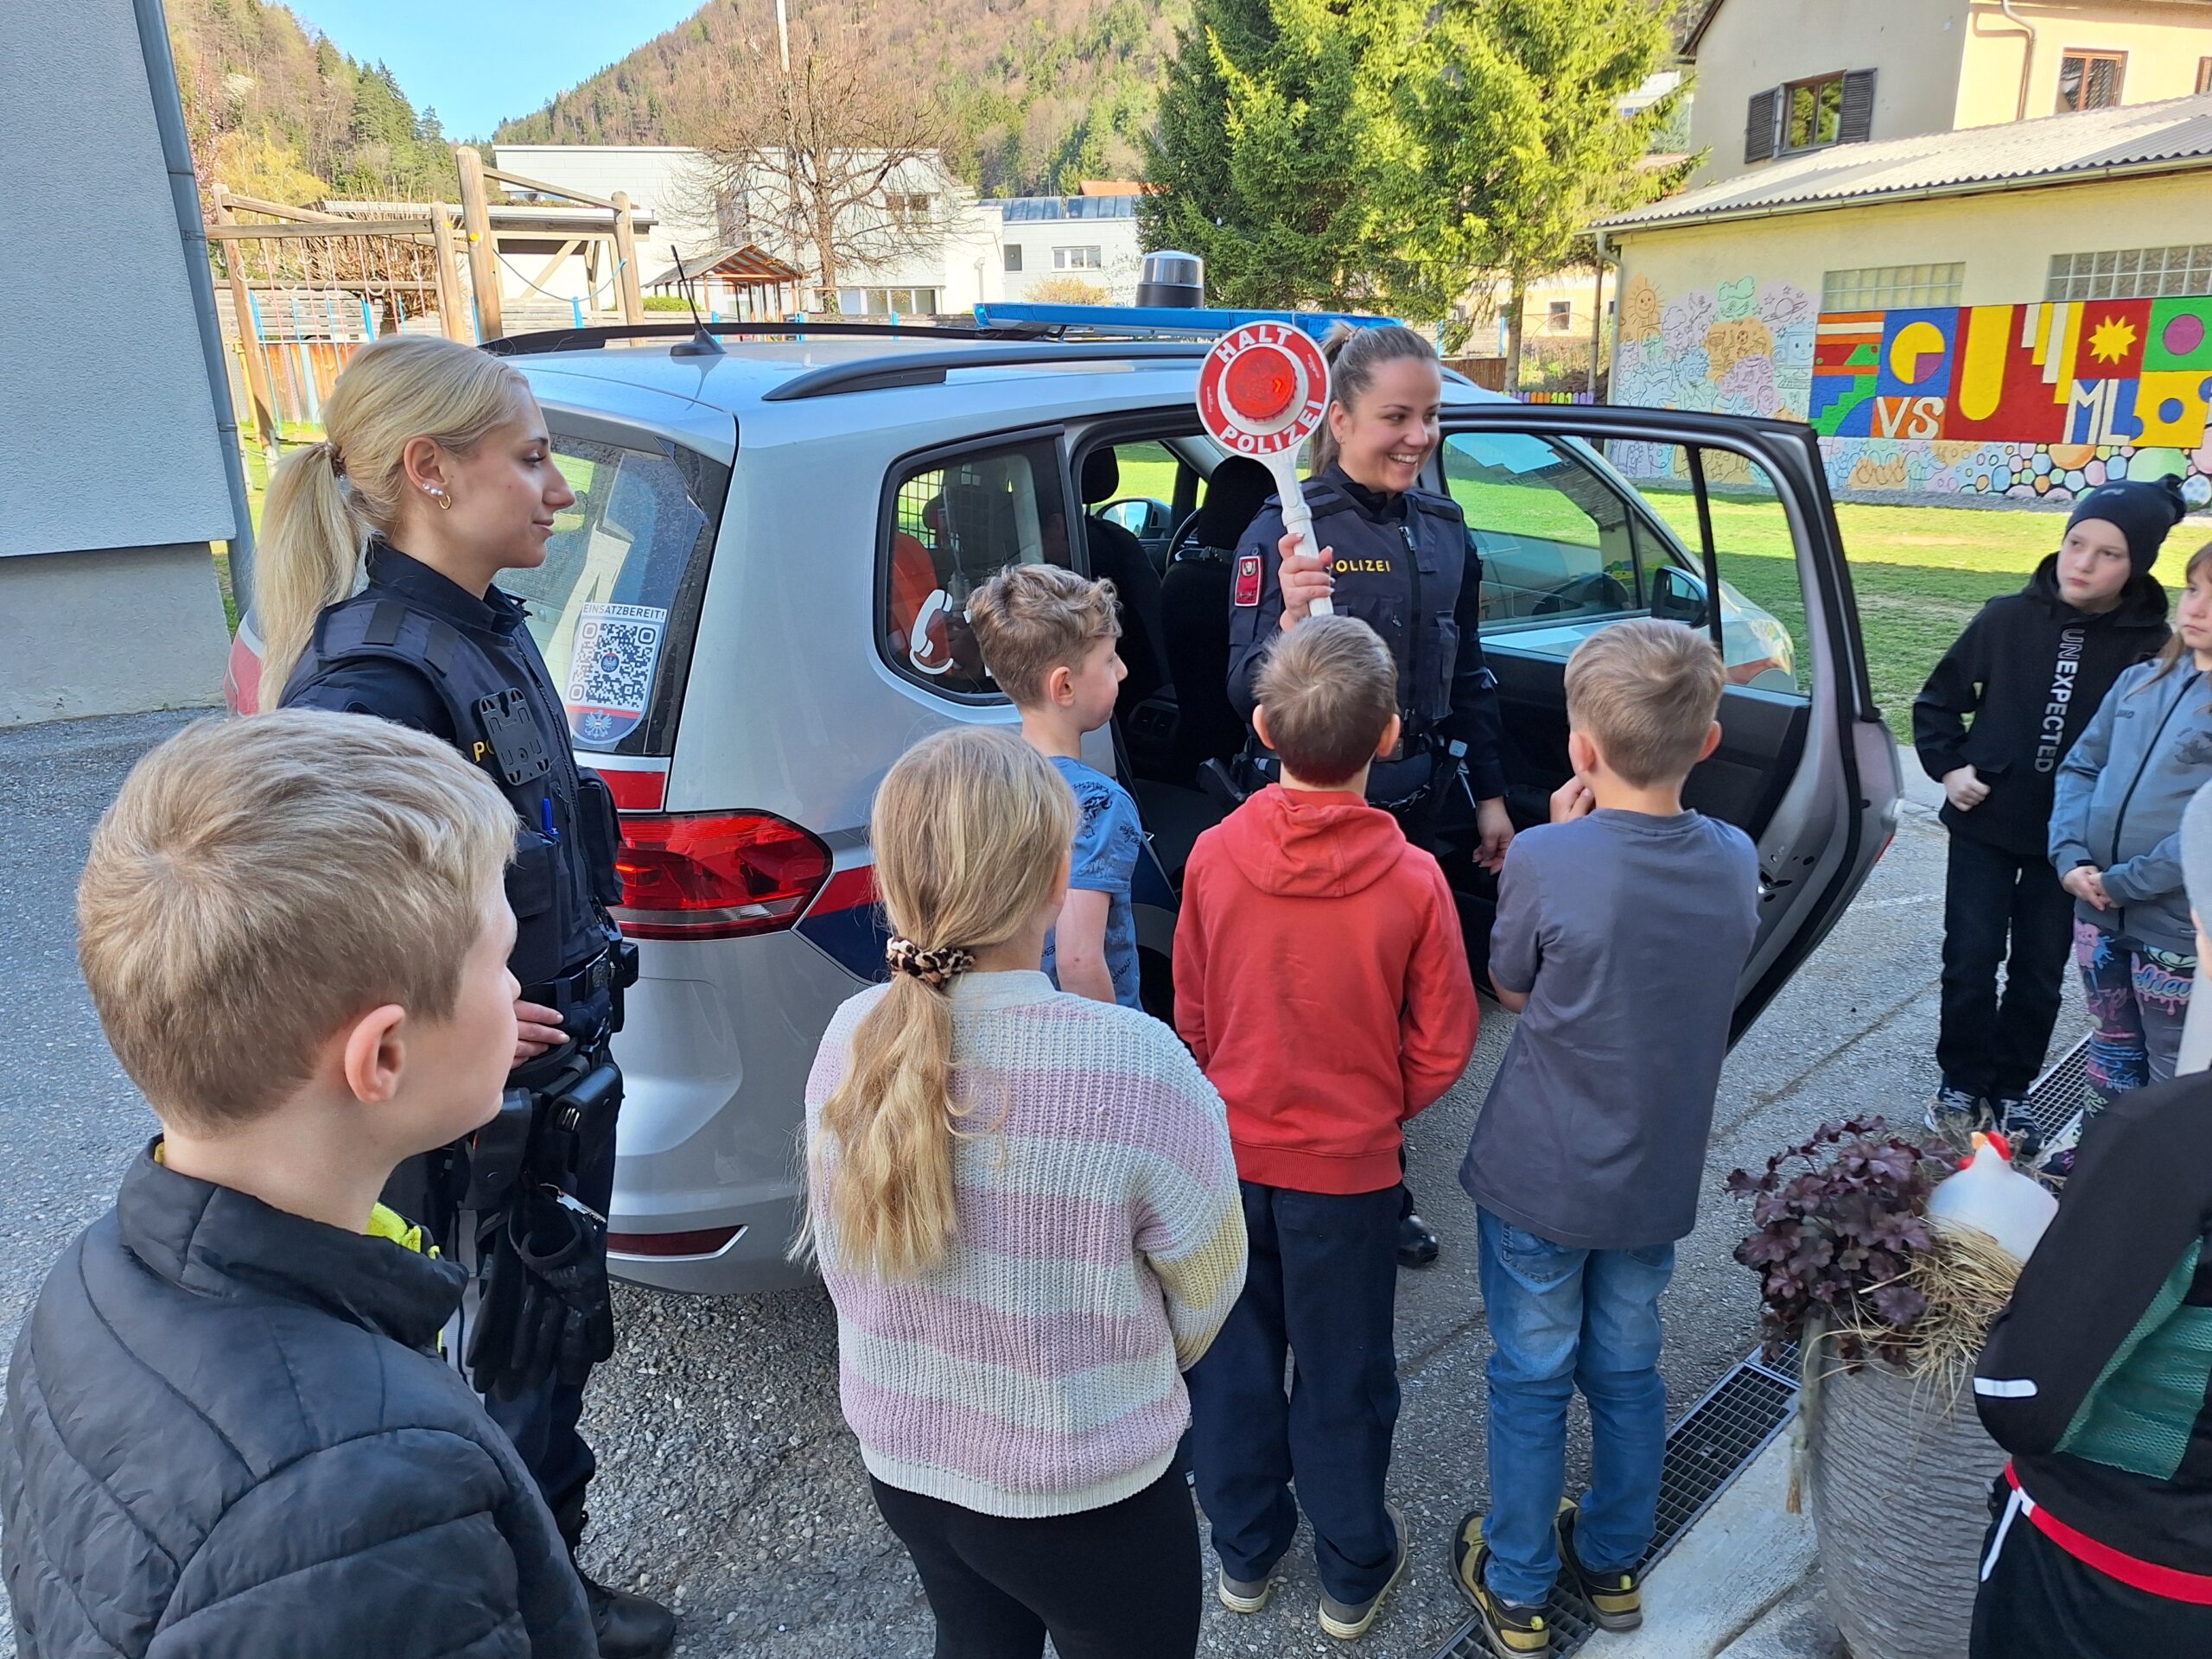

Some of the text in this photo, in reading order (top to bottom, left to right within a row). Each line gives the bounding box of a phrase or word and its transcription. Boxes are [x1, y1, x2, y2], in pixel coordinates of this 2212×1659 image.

[1215, 326, 1293, 364] HALT
[1219, 399, 1323, 454] POLIZEI
[1876, 396, 1945, 440] VS
[2063, 378, 2131, 445] ML
[1331, 559, 1391, 573] OLIZEI
[583, 603, 665, 620] EINSATZBEREIT!
[2035, 628, 2085, 772] UNEXPECTED
